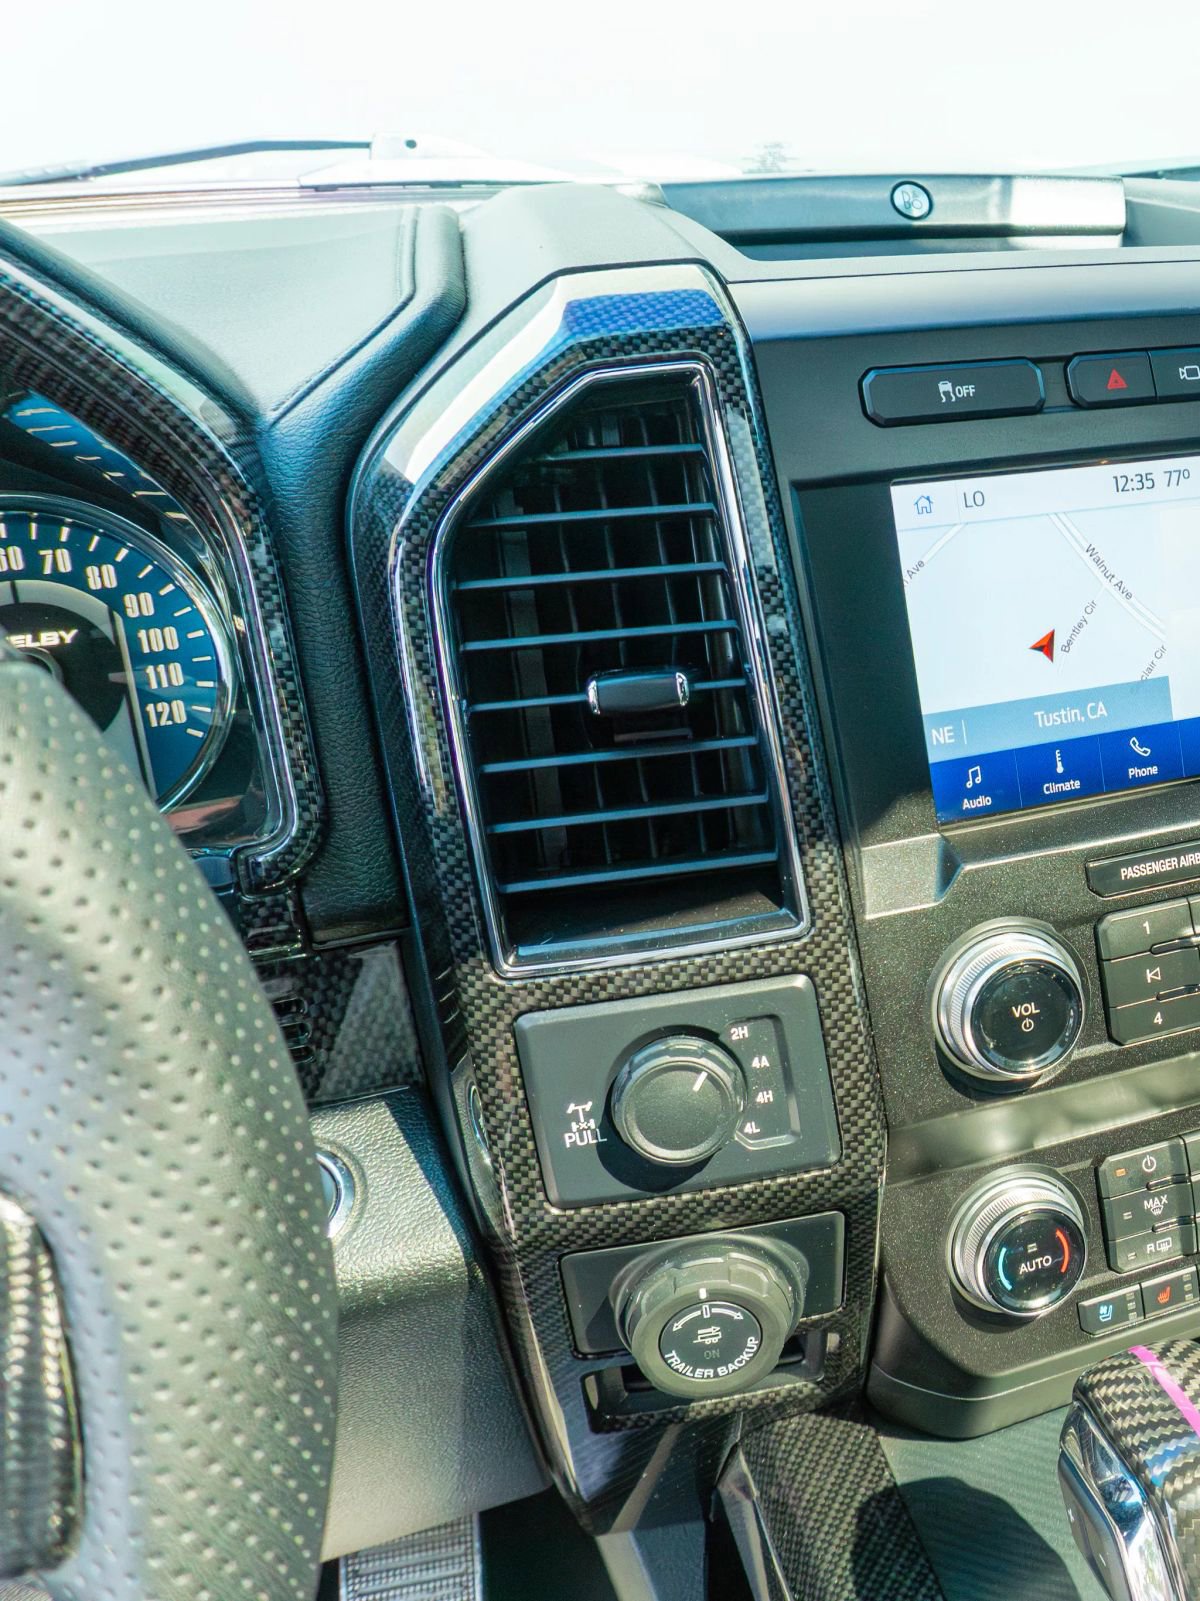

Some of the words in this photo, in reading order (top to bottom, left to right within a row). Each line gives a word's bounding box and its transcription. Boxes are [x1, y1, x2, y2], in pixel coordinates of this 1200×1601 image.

[955, 385, 976, 398] OFF
[1112, 472, 1156, 493] 12:35
[963, 490, 985, 508] LO
[38, 548, 72, 575] 70
[906, 560, 925, 580] Ave
[85, 563, 118, 590] 80
[1085, 544, 1115, 583] Walnut
[1113, 578, 1133, 601] Ave
[123, 591, 155, 618] 90
[1061, 614, 1089, 654] Bentley
[1083, 599, 1097, 615] Cir
[8, 629, 79, 648] ELBY
[137, 625, 180, 653] 100
[1141, 659, 1157, 681] clair
[1154, 644, 1167, 660] Cir
[145, 662, 185, 689] 110
[145, 699, 187, 728] 120
[1034, 706, 1085, 728] Tustin,
[1087, 701, 1108, 719] CA
[931, 726, 955, 746] NE
[1128, 764, 1158, 779] Phone
[1043, 779, 1081, 795] Climate
[962, 796, 992, 810] Audio
[1120, 857, 1179, 880] PASSENGER
[1142, 921, 1150, 934] 1
[1012, 1003, 1040, 1017] VOL
[1153, 1011, 1163, 1025] 4
[730, 1026, 749, 1041] 2H
[751, 1055, 770, 1069] 4A
[756, 1090, 774, 1104] 4H
[743, 1120, 760, 1134] 4L
[564, 1128, 608, 1148] PULL
[1144, 1194, 1169, 1210] MAX
[1147, 1243, 1155, 1253] R
[1018, 1254, 1052, 1275] AUTO
[664, 1350, 714, 1379] TRAILER
[717, 1336, 760, 1378] BACKUP
[704, 1349, 720, 1360] ON
